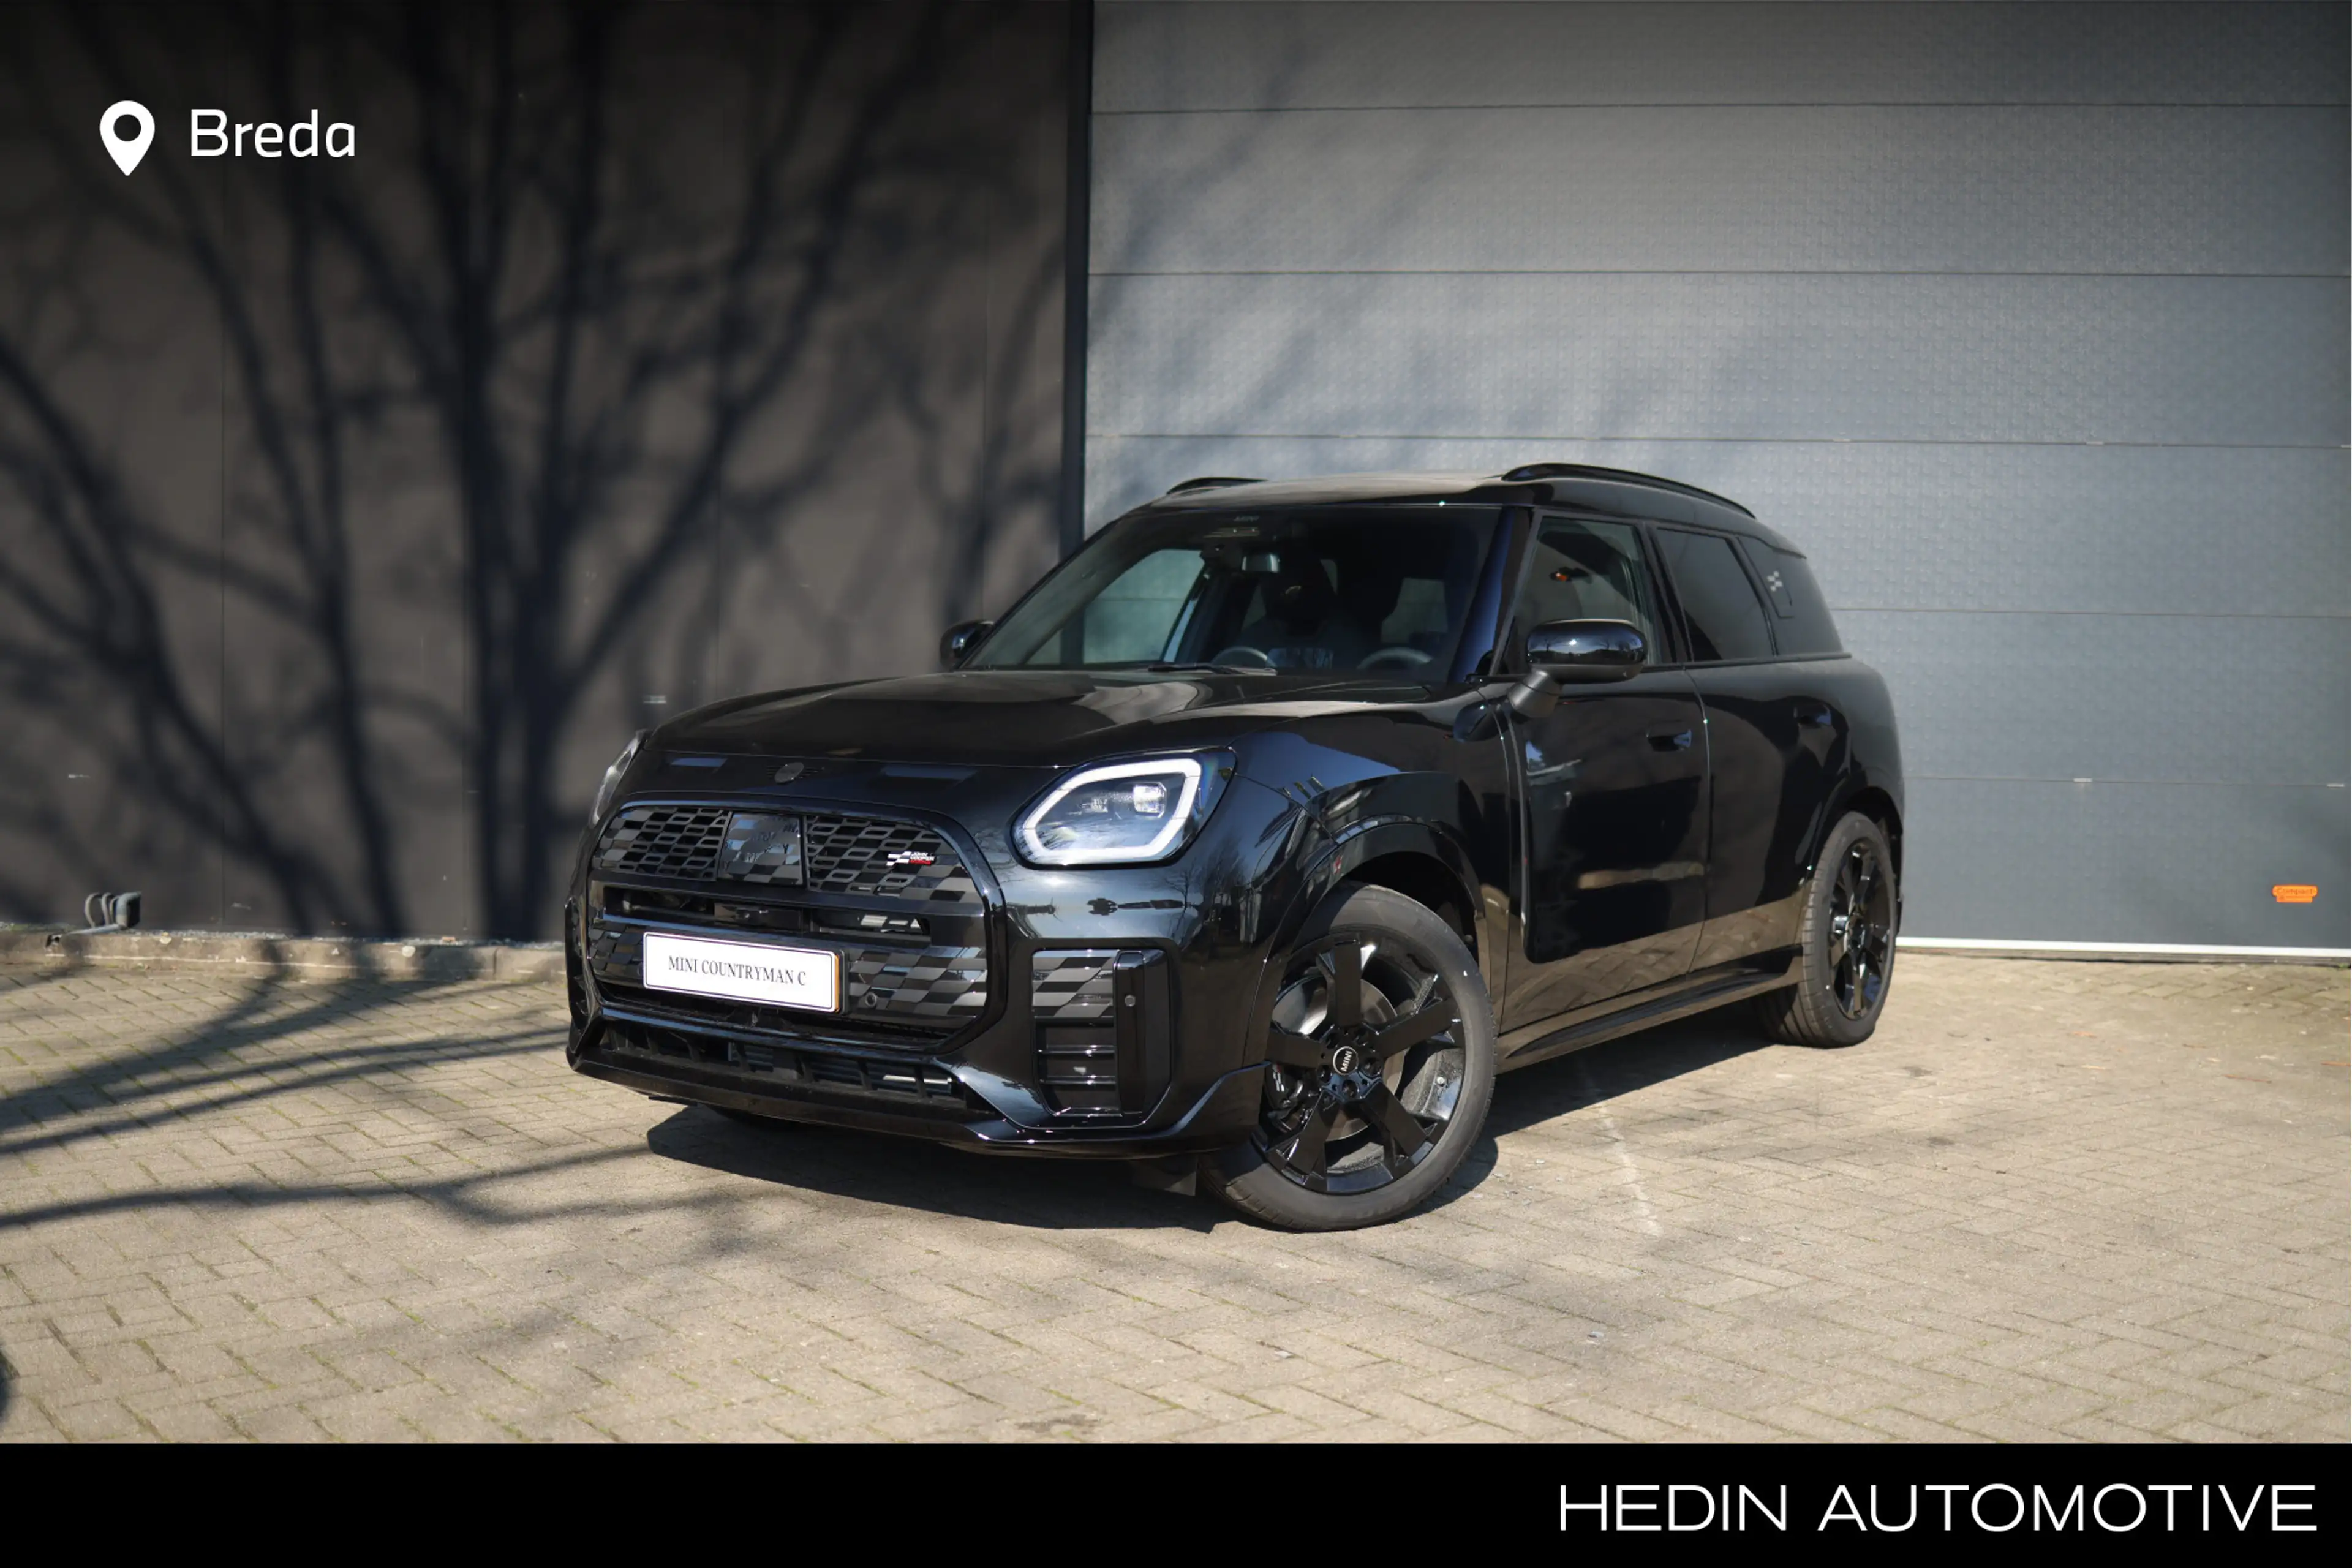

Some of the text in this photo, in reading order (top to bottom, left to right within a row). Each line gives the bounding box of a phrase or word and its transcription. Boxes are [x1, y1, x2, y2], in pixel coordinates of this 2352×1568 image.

[669, 956, 806, 986] MINI COUNTRYMAN C
[1340, 1050, 1352, 1071] MINI
